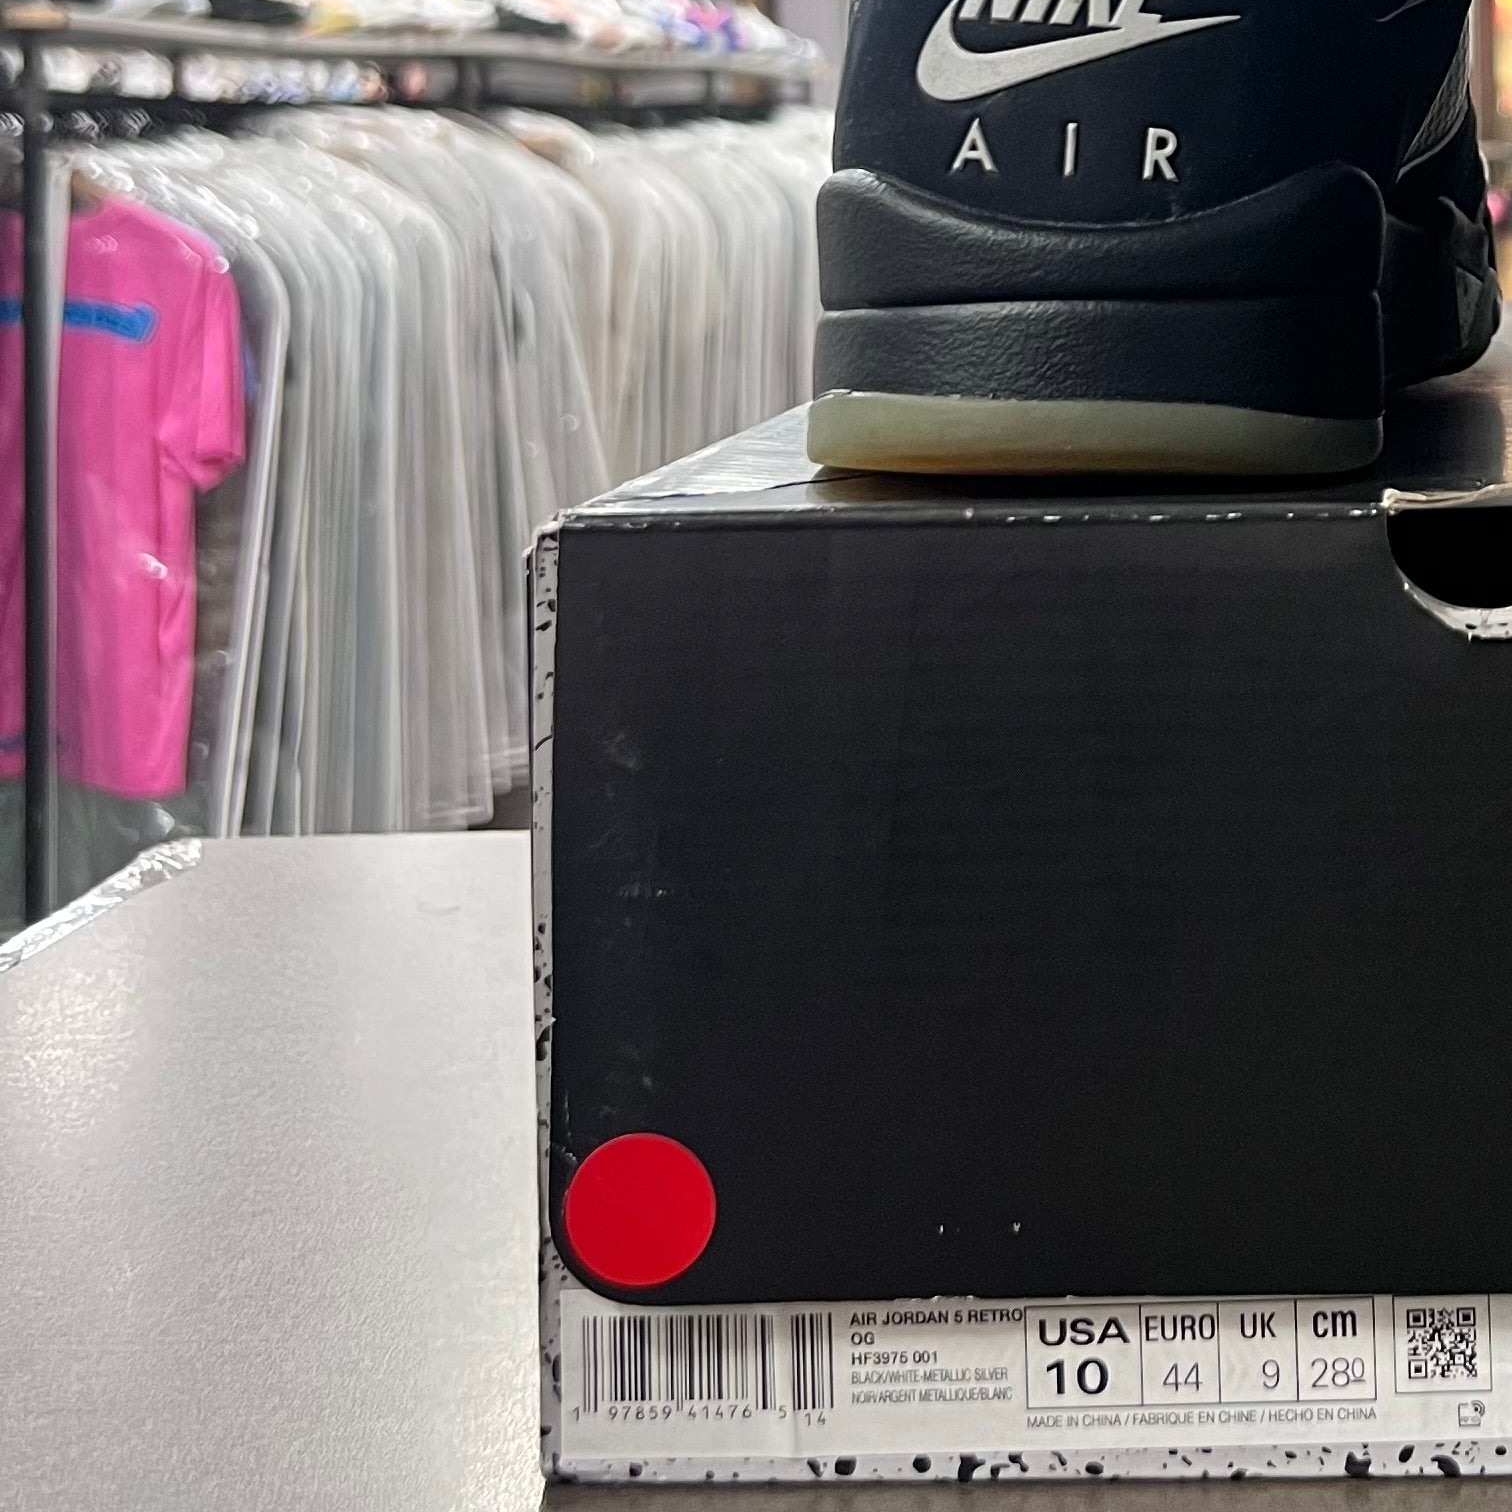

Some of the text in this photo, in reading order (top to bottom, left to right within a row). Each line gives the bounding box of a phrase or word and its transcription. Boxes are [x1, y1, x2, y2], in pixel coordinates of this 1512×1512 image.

[951, 117, 1180, 183] AIR
[850, 1308, 1023, 1326] AIR JORDAN 5 RETRO
[1038, 1310, 1357, 1346] USA EURO UK cm
[850, 1331, 875, 1346] OG
[912, 1350, 938, 1365] 001
[974, 1367, 1008, 1382] SILVER
[1045, 1357, 1110, 1395] 10
[1162, 1361, 1203, 1392] 44
[1261, 1358, 1281, 1389] 9
[804, 1410, 827, 1426] 14
[1026, 1414, 1063, 1428] MADE
[1066, 1414, 1079, 1428] IN
[1082, 1413, 1122, 1428] CHINA
[1132, 1410, 1194, 1426] FABRIQUE
[1198, 1410, 1215, 1424] EN
[1218, 1409, 1257, 1424] CHINE
[1268, 1407, 1314, 1423] HECHO
[1317, 1407, 1334, 1422] EN
[1337, 1406, 1377, 1421] CHINA
